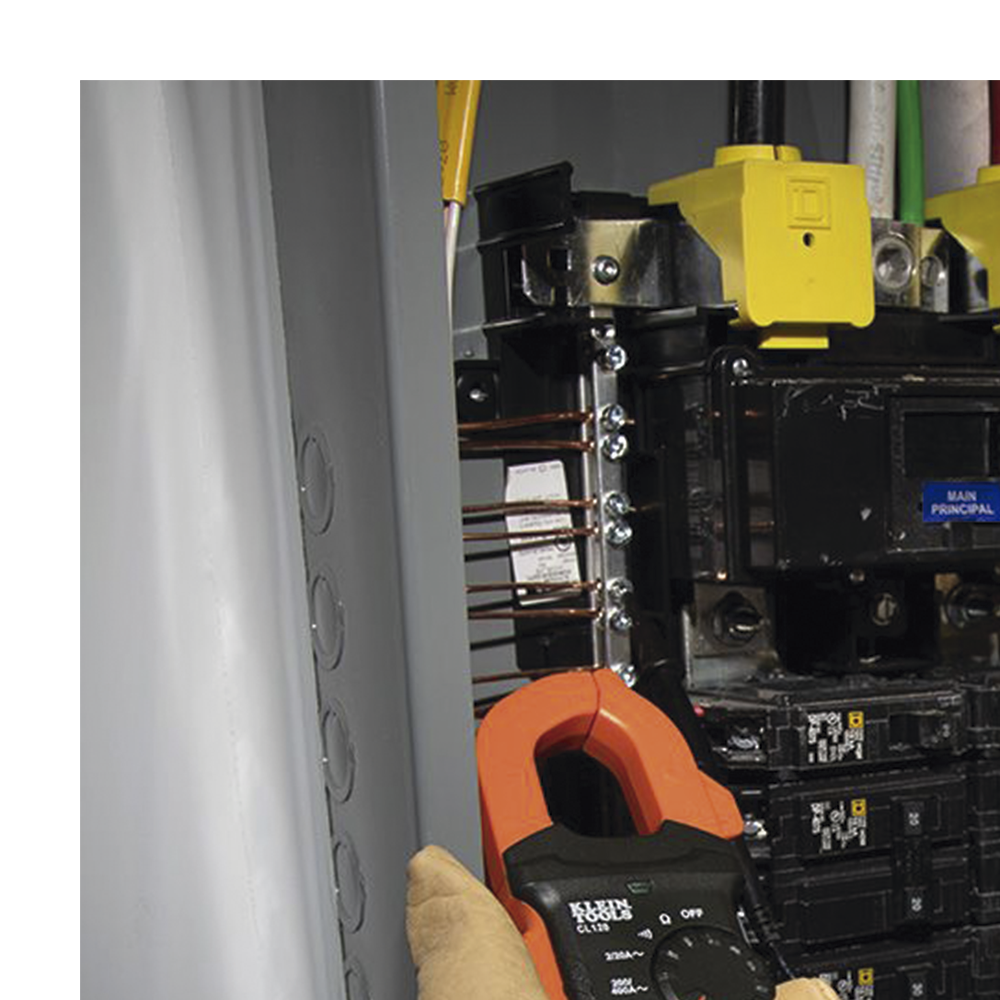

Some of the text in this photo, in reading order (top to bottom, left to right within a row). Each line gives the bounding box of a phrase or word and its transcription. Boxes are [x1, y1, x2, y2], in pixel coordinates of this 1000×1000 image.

[946, 490, 977, 502] MAIN
[930, 503, 995, 516] PRINCIPAL
[908, 811, 920, 826] 20
[568, 899, 632, 916] KLEIN
[910, 897, 922, 912] 20
[573, 909, 633, 923] TOOLS
[680, 908, 703, 919] OFF
